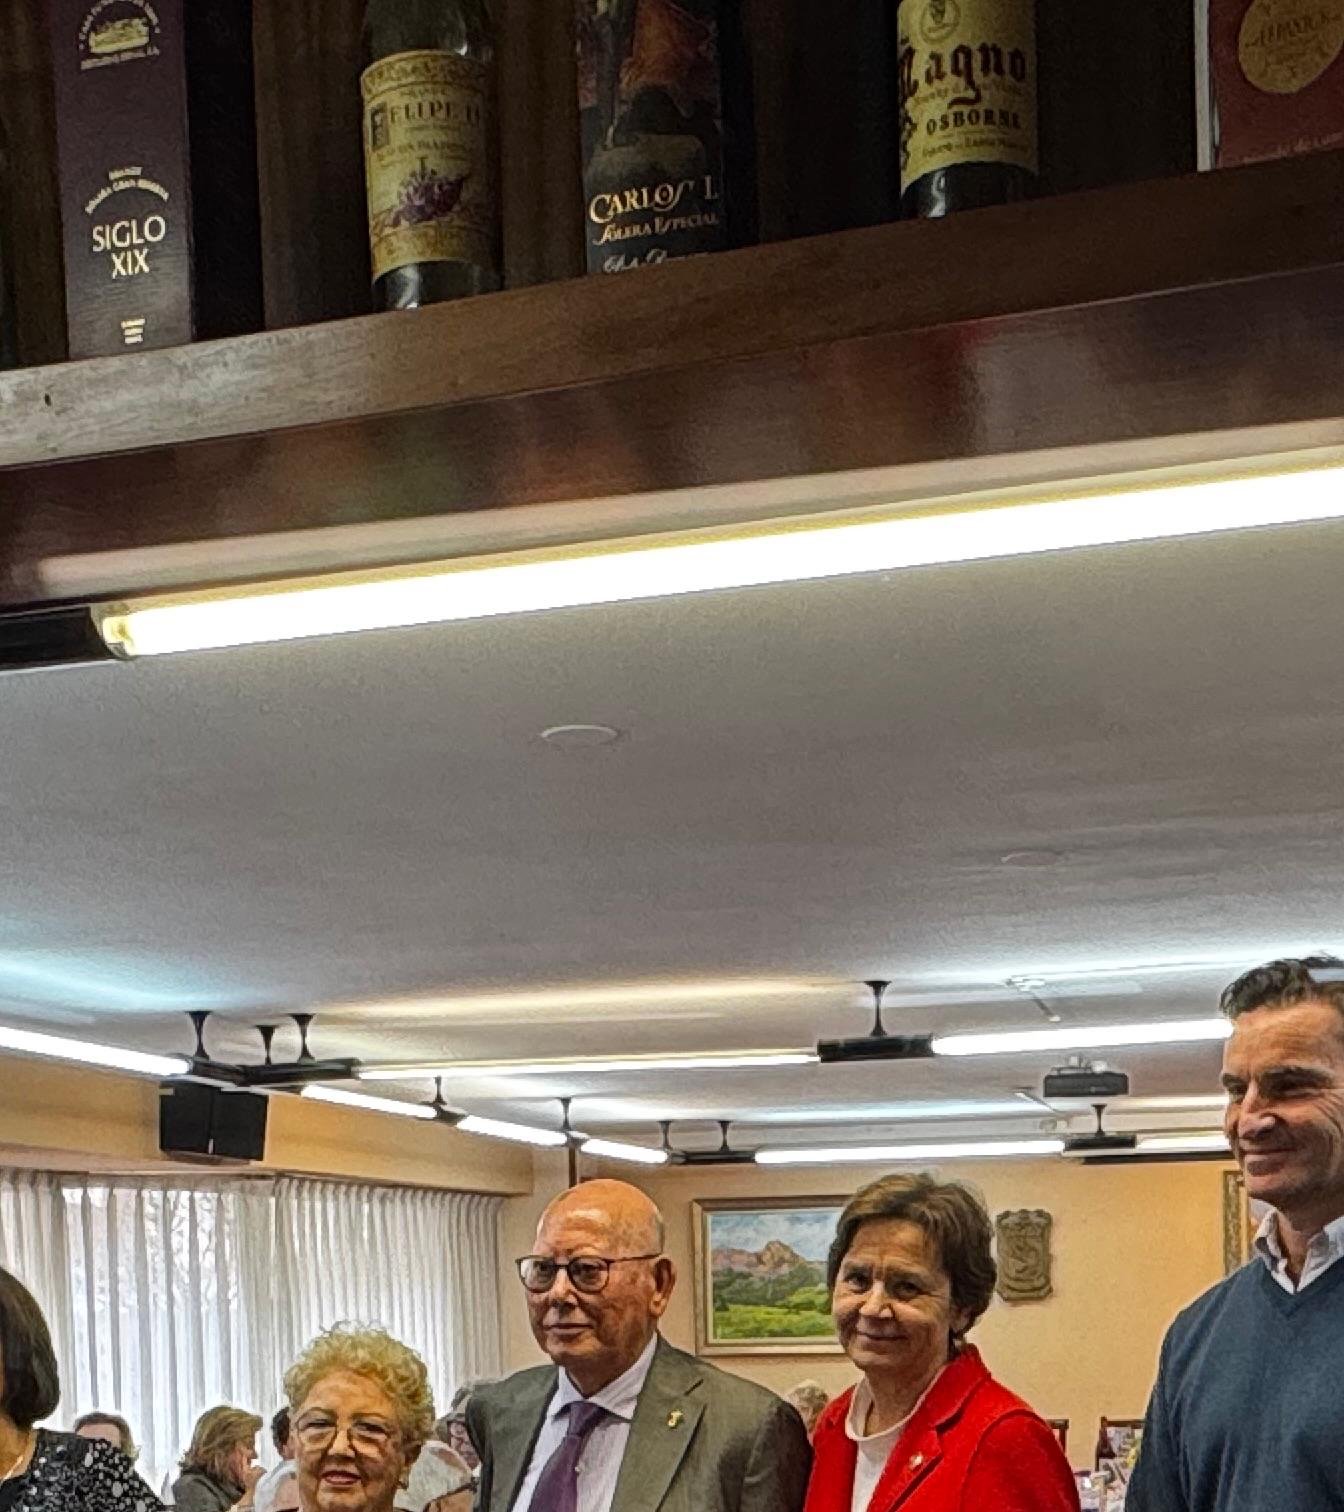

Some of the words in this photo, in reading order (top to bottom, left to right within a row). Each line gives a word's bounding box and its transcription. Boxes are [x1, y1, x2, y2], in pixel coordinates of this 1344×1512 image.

[926, 108, 1022, 136] OSBORNE
[590, 180, 695, 224] CARLOS
[92, 215, 166, 253] SIGLO
[110, 248, 150, 279] XIX
